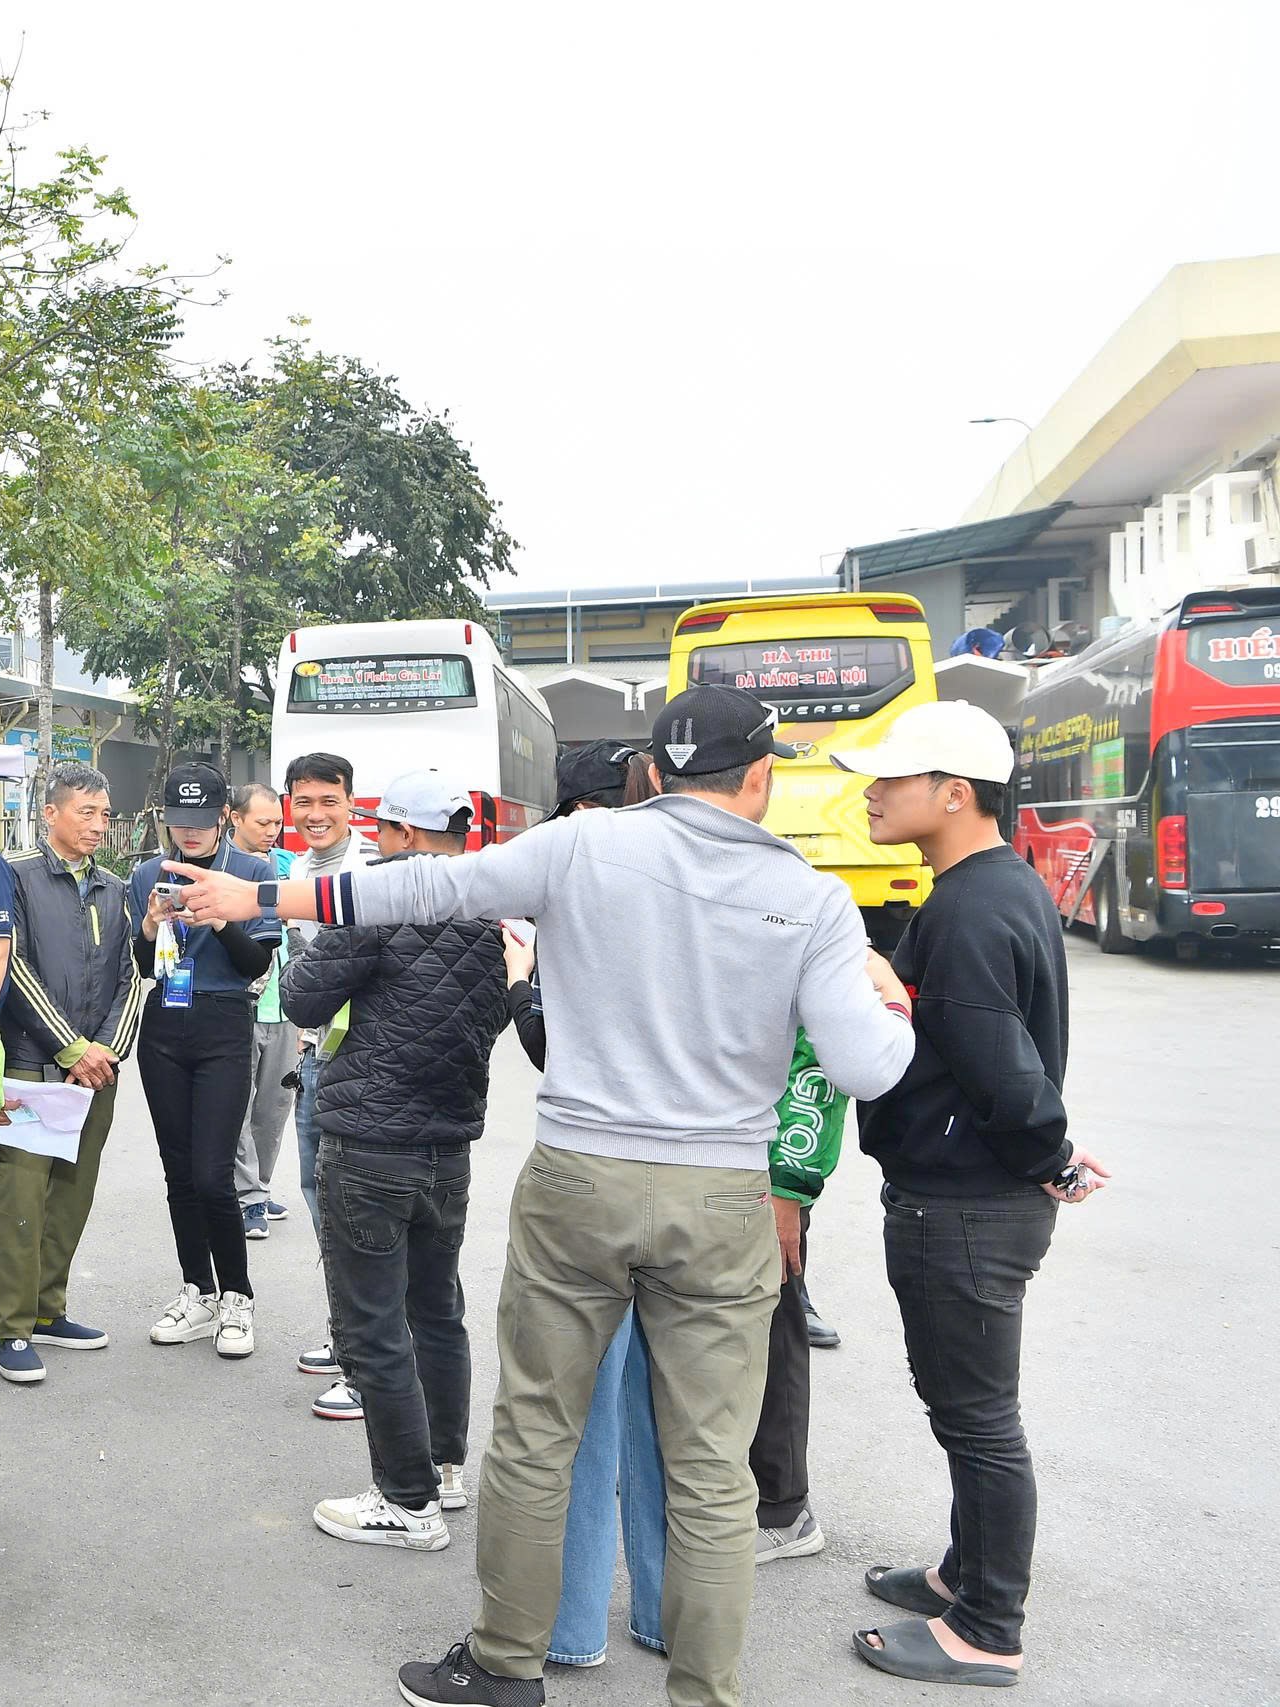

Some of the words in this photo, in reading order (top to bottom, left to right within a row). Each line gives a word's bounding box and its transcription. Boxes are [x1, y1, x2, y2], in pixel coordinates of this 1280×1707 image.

[762, 646, 792, 664] HÀ
[797, 648, 831, 662] THI
[398, 669, 420, 681] Gia
[423, 669, 441, 680] Lai
[736, 671, 756, 688] ĐÀ
[816, 667, 837, 685] HÀ
[841, 666, 867, 686] NỘI
[317, 701, 445, 710] GRANBIRD
[780, 704, 861, 715] VERSE
[179, 783, 201, 796] GS
[762, 914, 786, 926] JDX
[420, 1522, 431, 1530] 33
